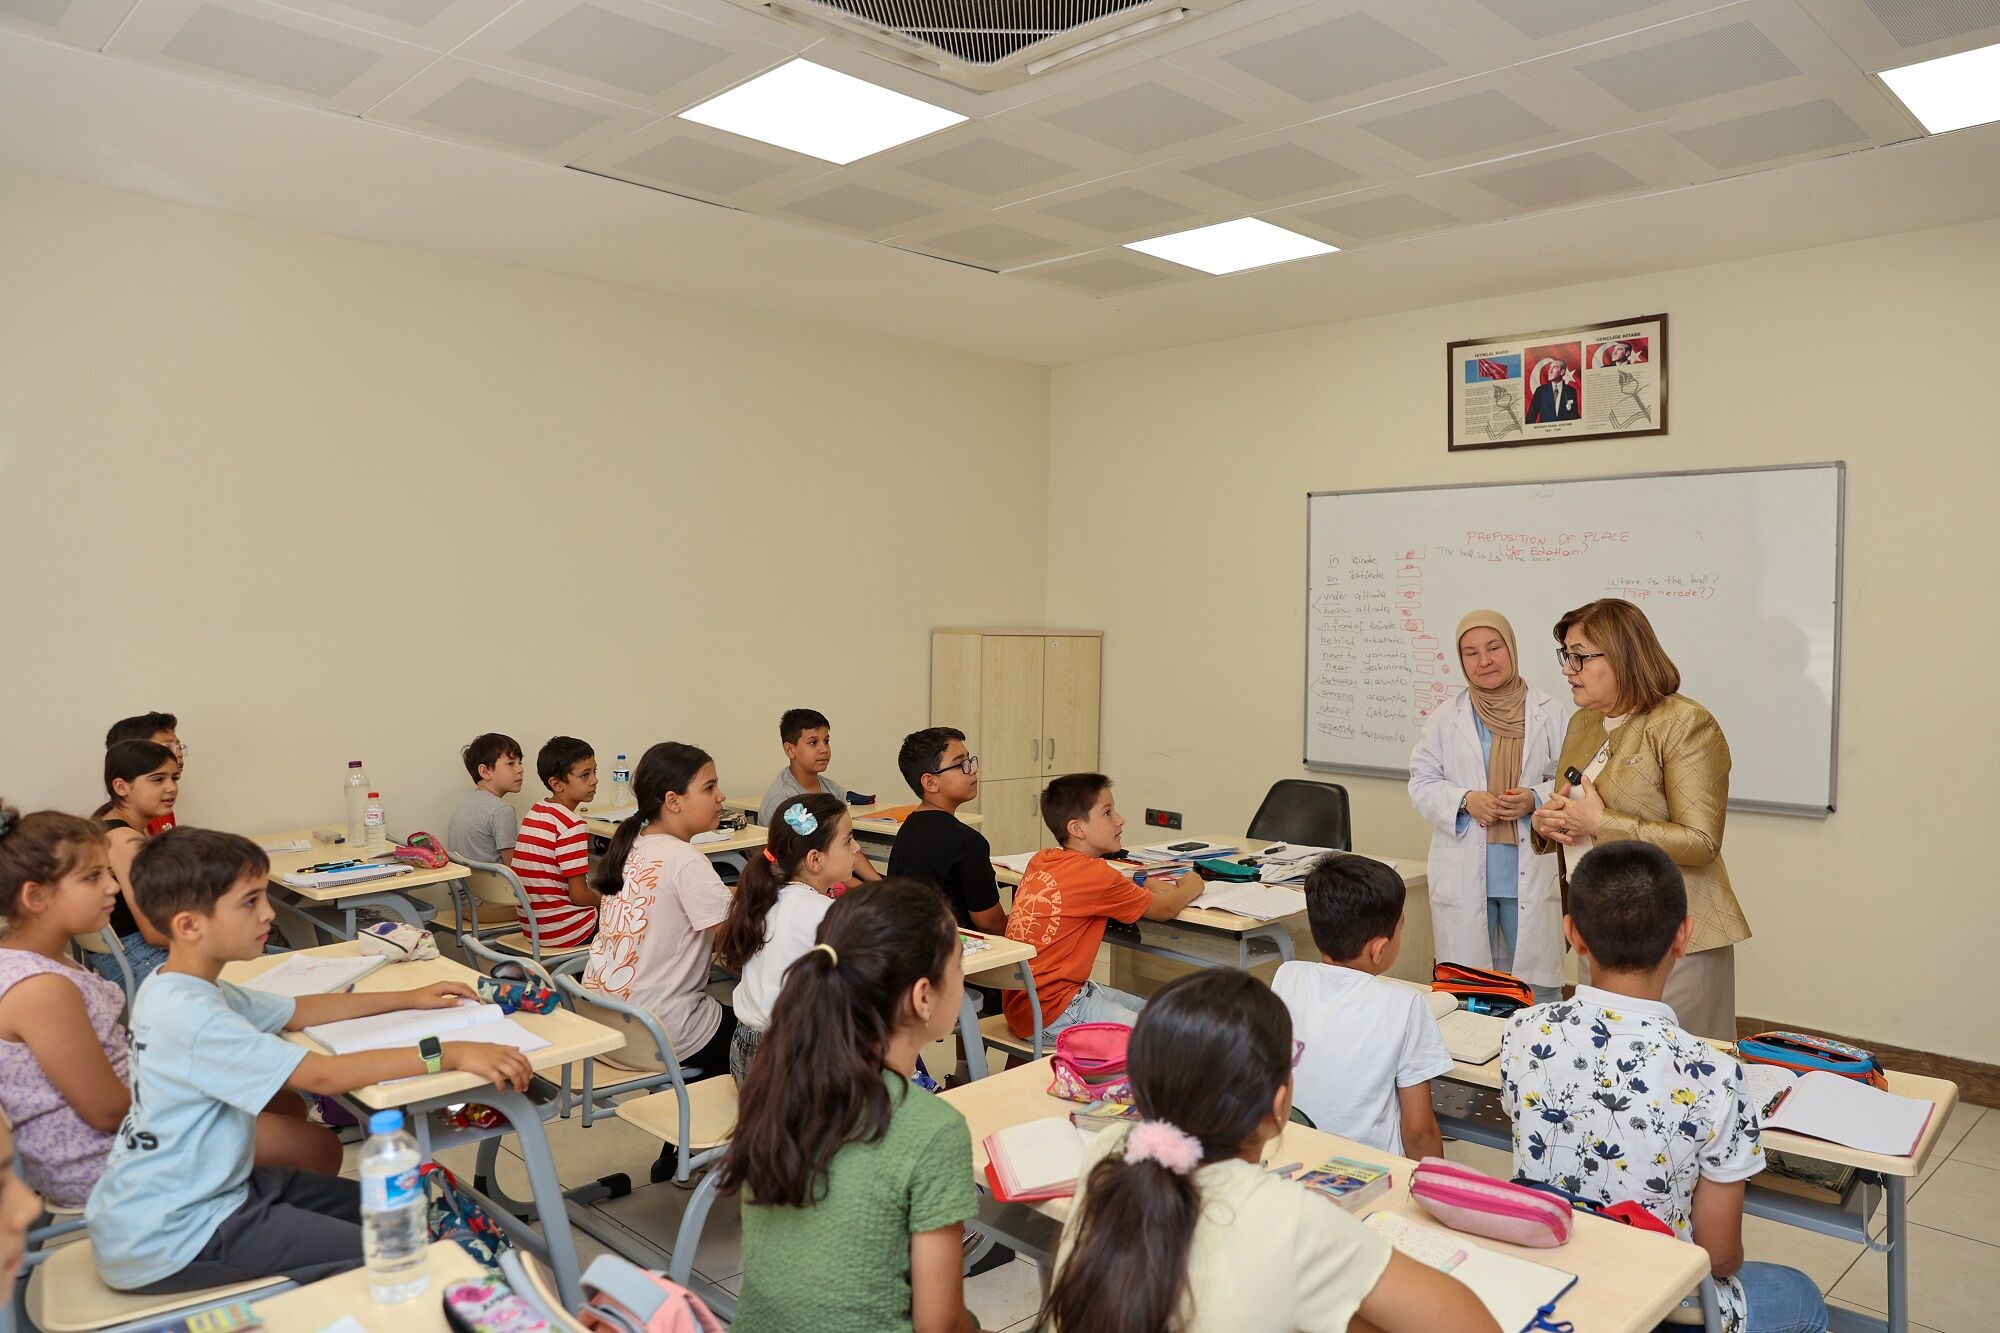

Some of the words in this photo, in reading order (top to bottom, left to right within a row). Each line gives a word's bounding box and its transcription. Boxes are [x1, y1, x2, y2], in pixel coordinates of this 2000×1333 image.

[1467, 531, 1546, 545] PREPOSITION
[1558, 535, 1576, 546] OF
[1584, 531, 1631, 545] PLACE
[1037, 870, 1058, 889] THE
[1042, 890, 1062, 944] WAVES
